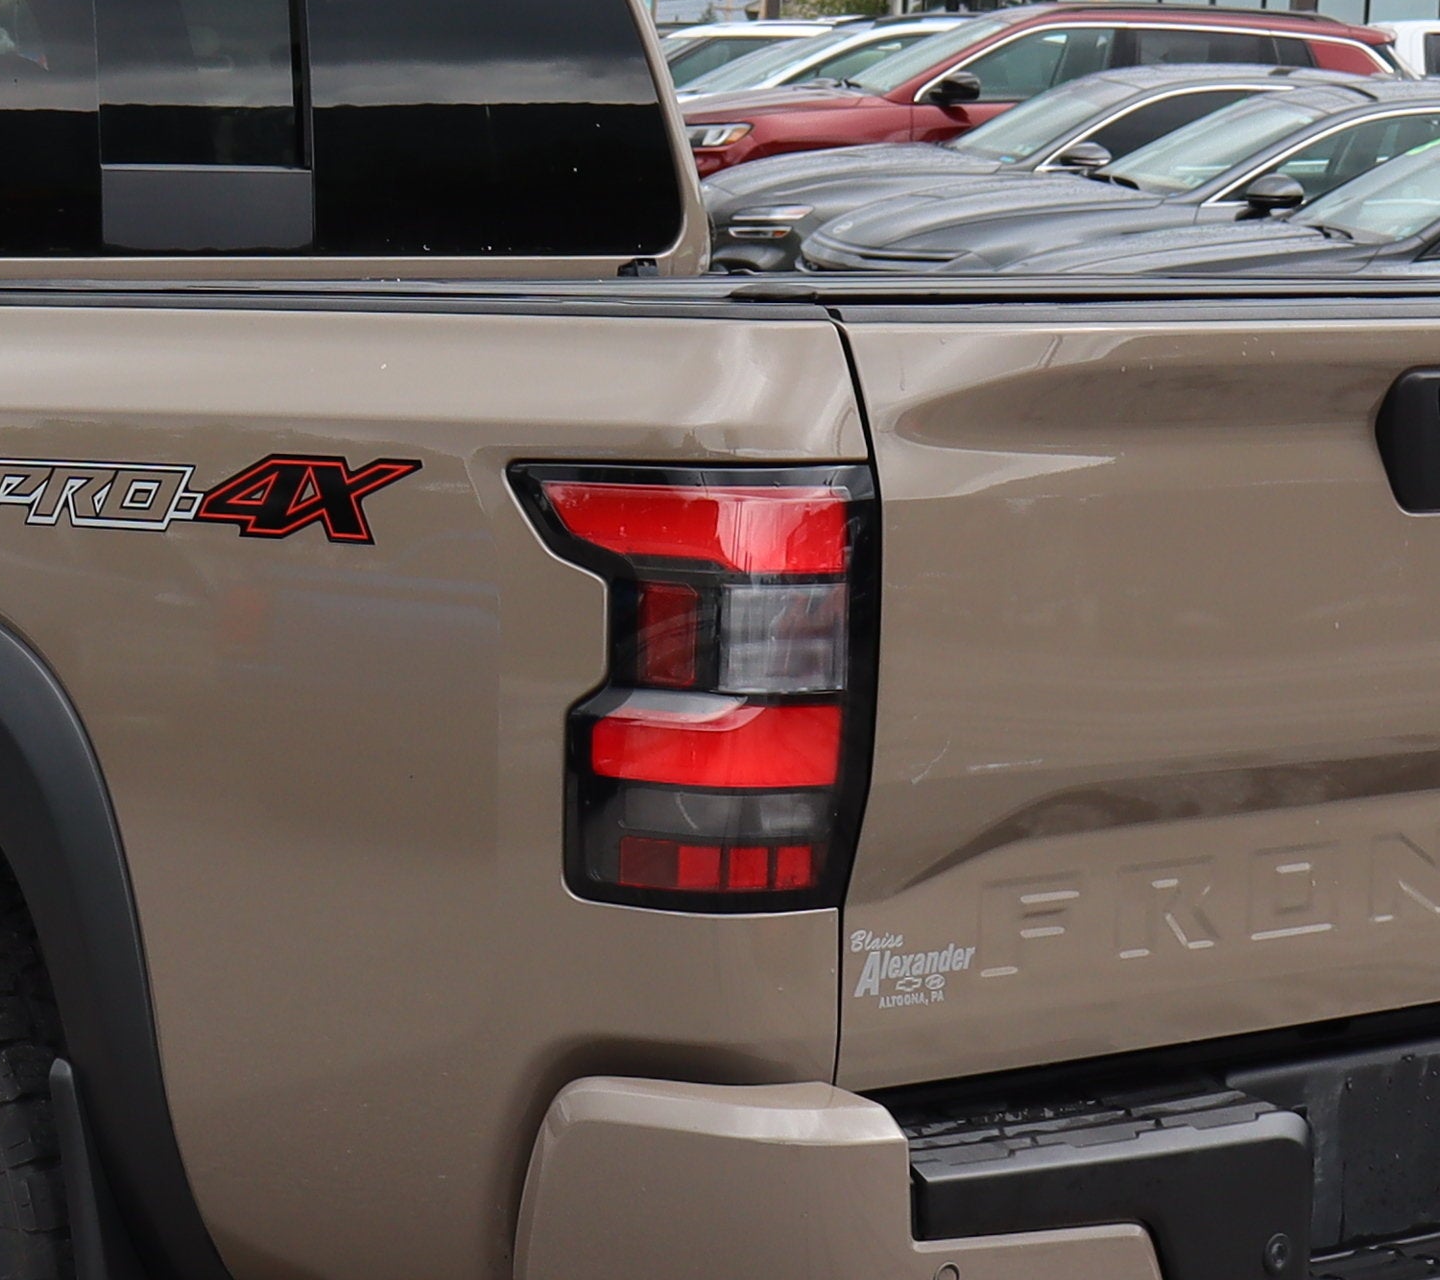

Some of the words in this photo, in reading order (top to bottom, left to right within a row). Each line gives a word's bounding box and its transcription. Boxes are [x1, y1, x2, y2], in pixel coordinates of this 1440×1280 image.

[850, 929, 903, 952] Blaise
[854, 942, 976, 998] Alexander
[931, 990, 944, 1003] PA
